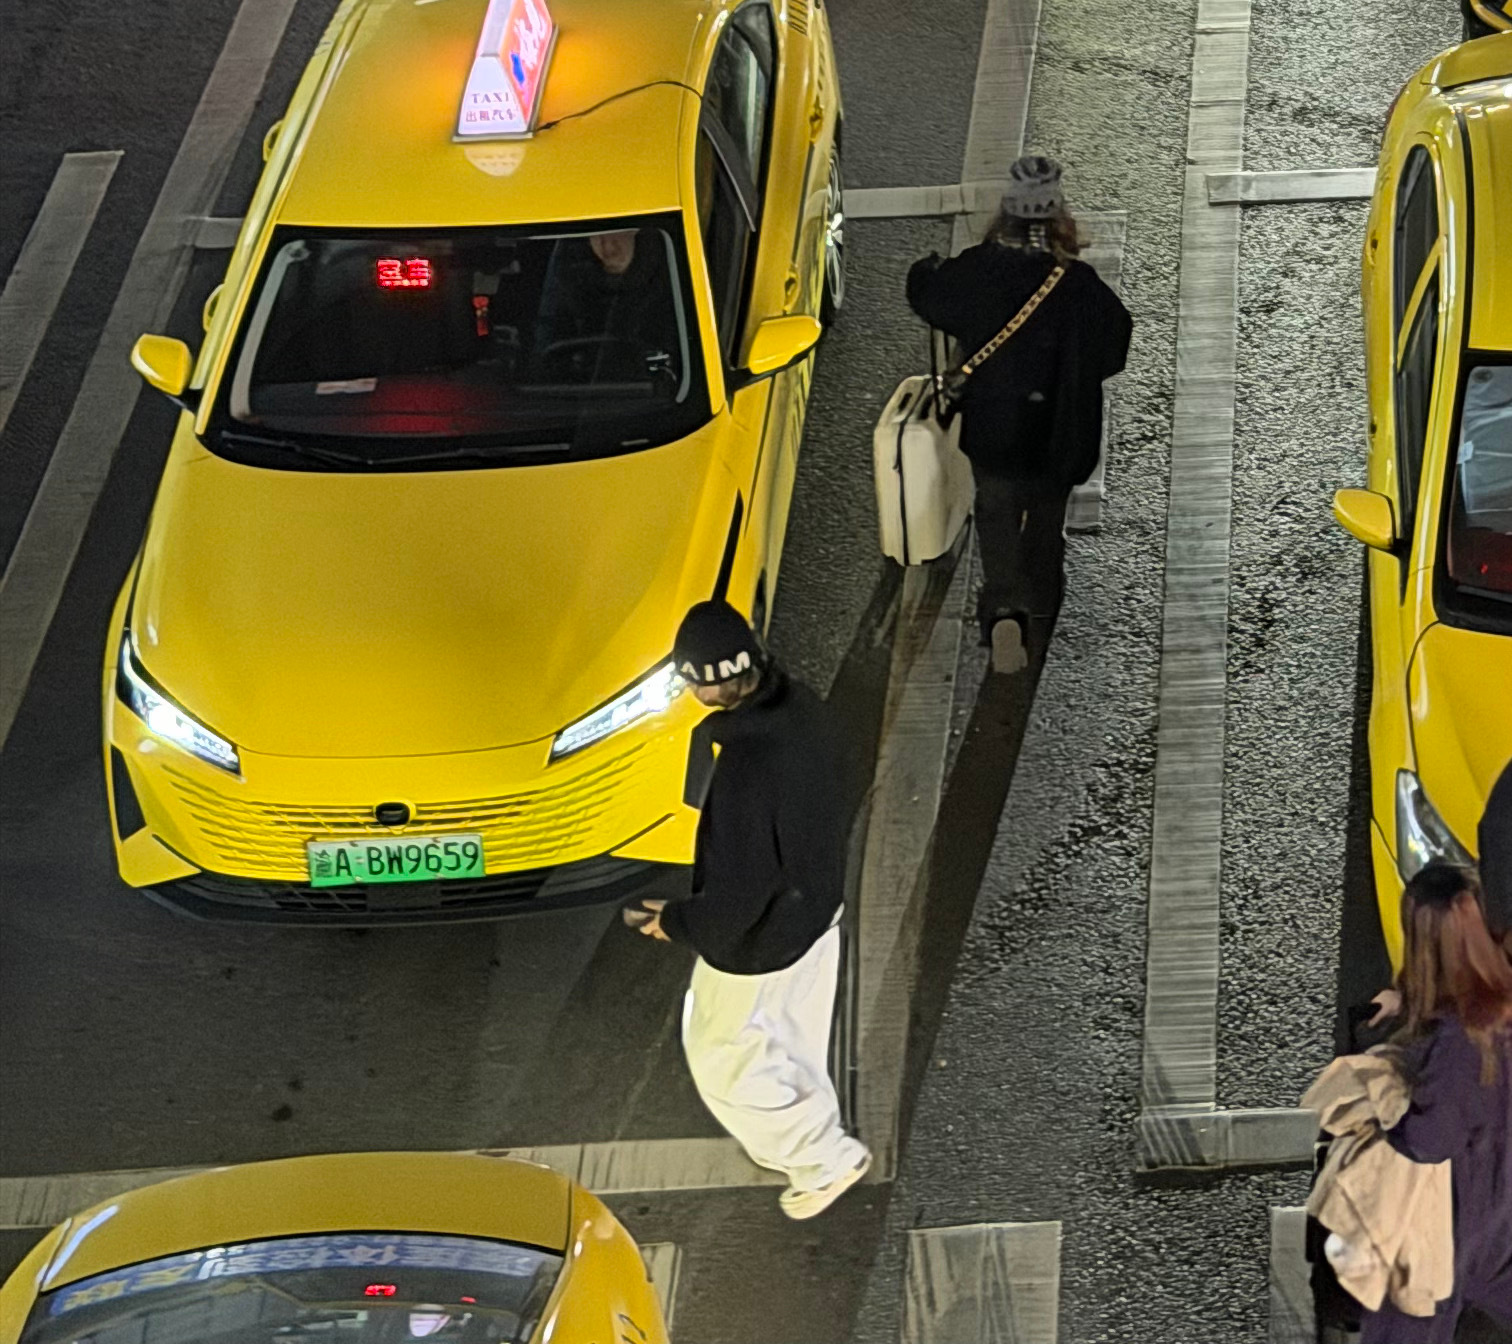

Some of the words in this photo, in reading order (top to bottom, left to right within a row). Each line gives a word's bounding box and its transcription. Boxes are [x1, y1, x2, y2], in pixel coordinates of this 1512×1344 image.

[471, 92, 511, 104] TAXI
[464, 108, 518, 123] 出租汽车
[313, 847, 352, 878] 渝A
[367, 840, 480, 877] BW9659
